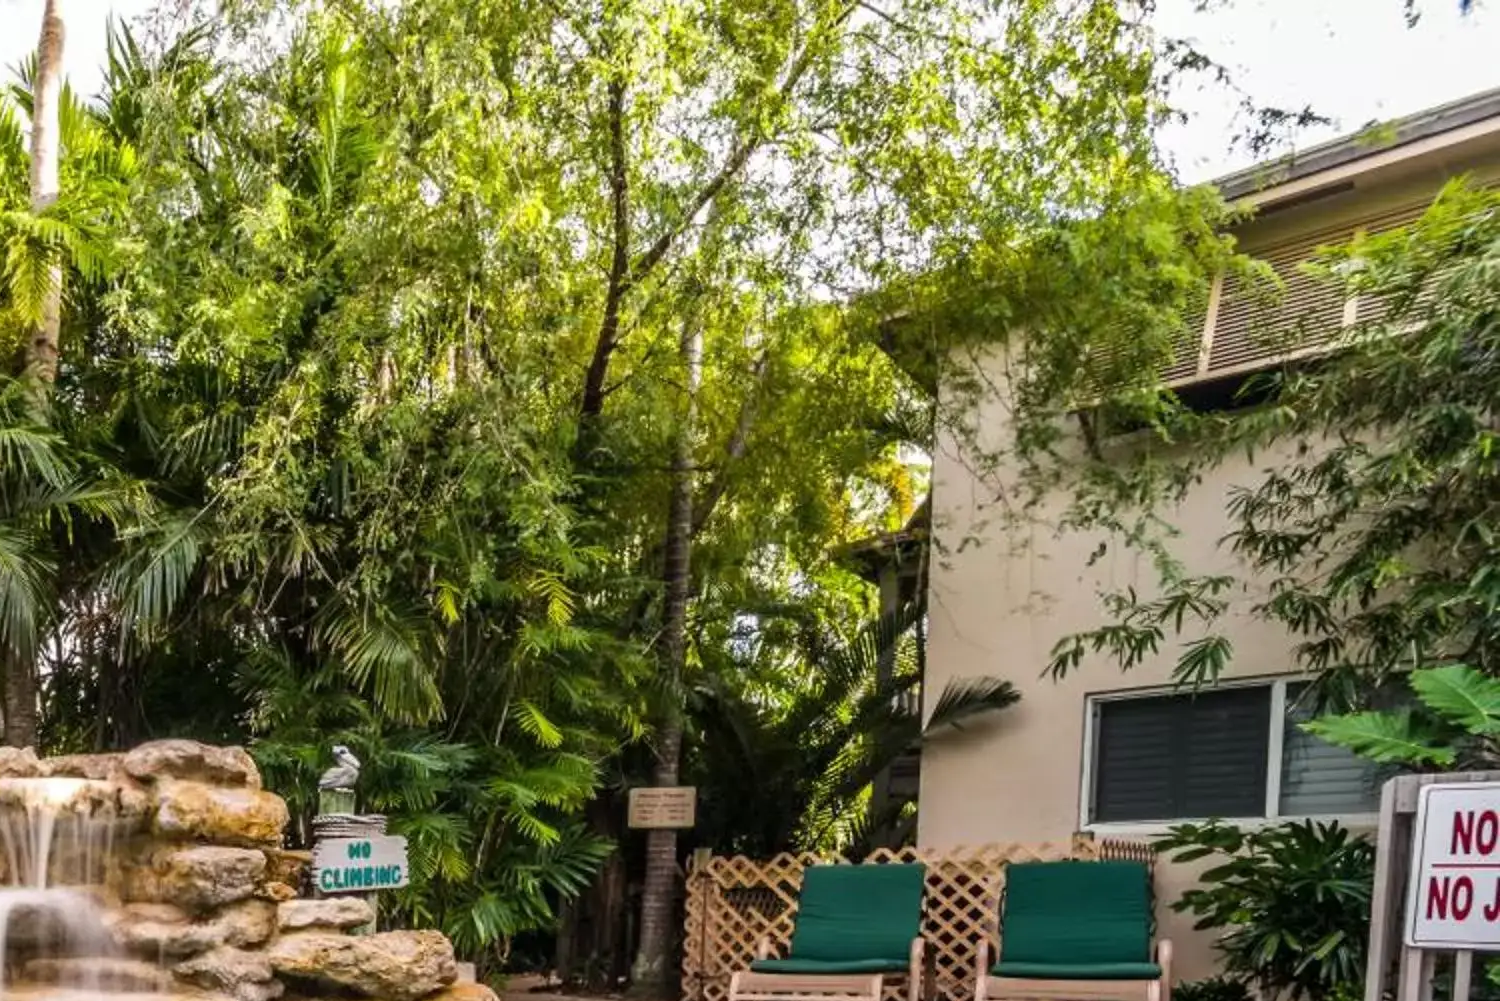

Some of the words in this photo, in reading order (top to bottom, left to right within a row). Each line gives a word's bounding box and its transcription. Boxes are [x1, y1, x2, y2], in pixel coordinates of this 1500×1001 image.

[1450, 810, 1498, 855] NO
[348, 841, 371, 859] NO
[321, 865, 402, 889] CLIMBING
[1426, 875, 1473, 921] NO
